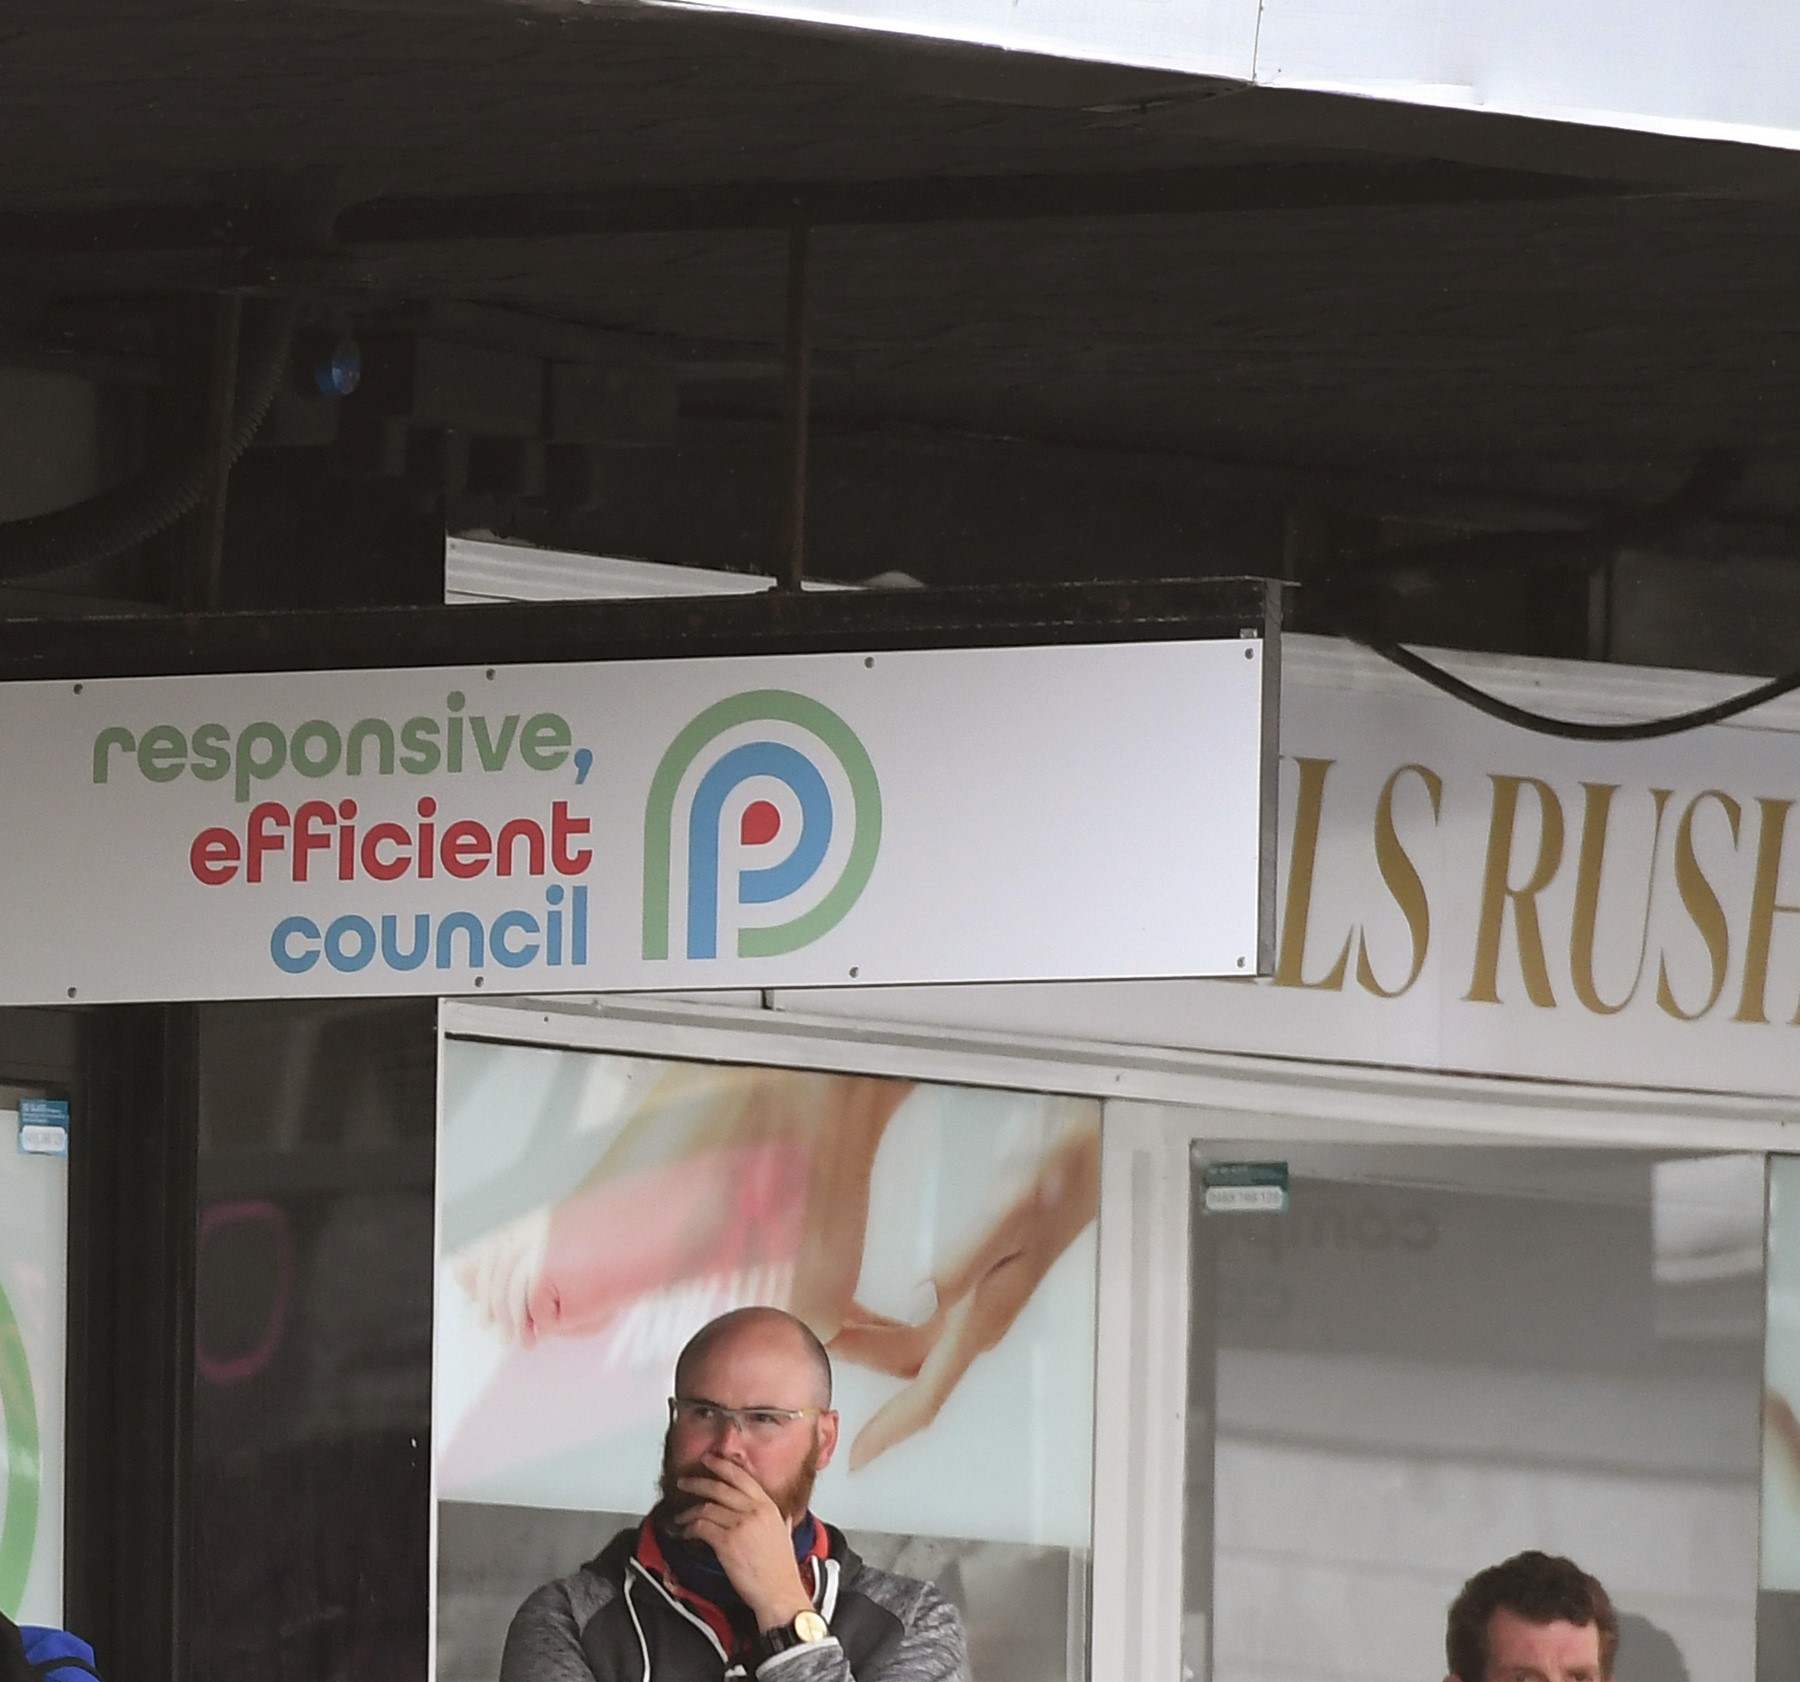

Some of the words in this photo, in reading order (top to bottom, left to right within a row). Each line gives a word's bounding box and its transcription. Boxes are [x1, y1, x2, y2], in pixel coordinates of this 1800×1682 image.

[91, 689, 595, 804] responsive,
[188, 796, 592, 886] efficient
[1268, 756, 1444, 998] LS
[269, 883, 588, 973] council
